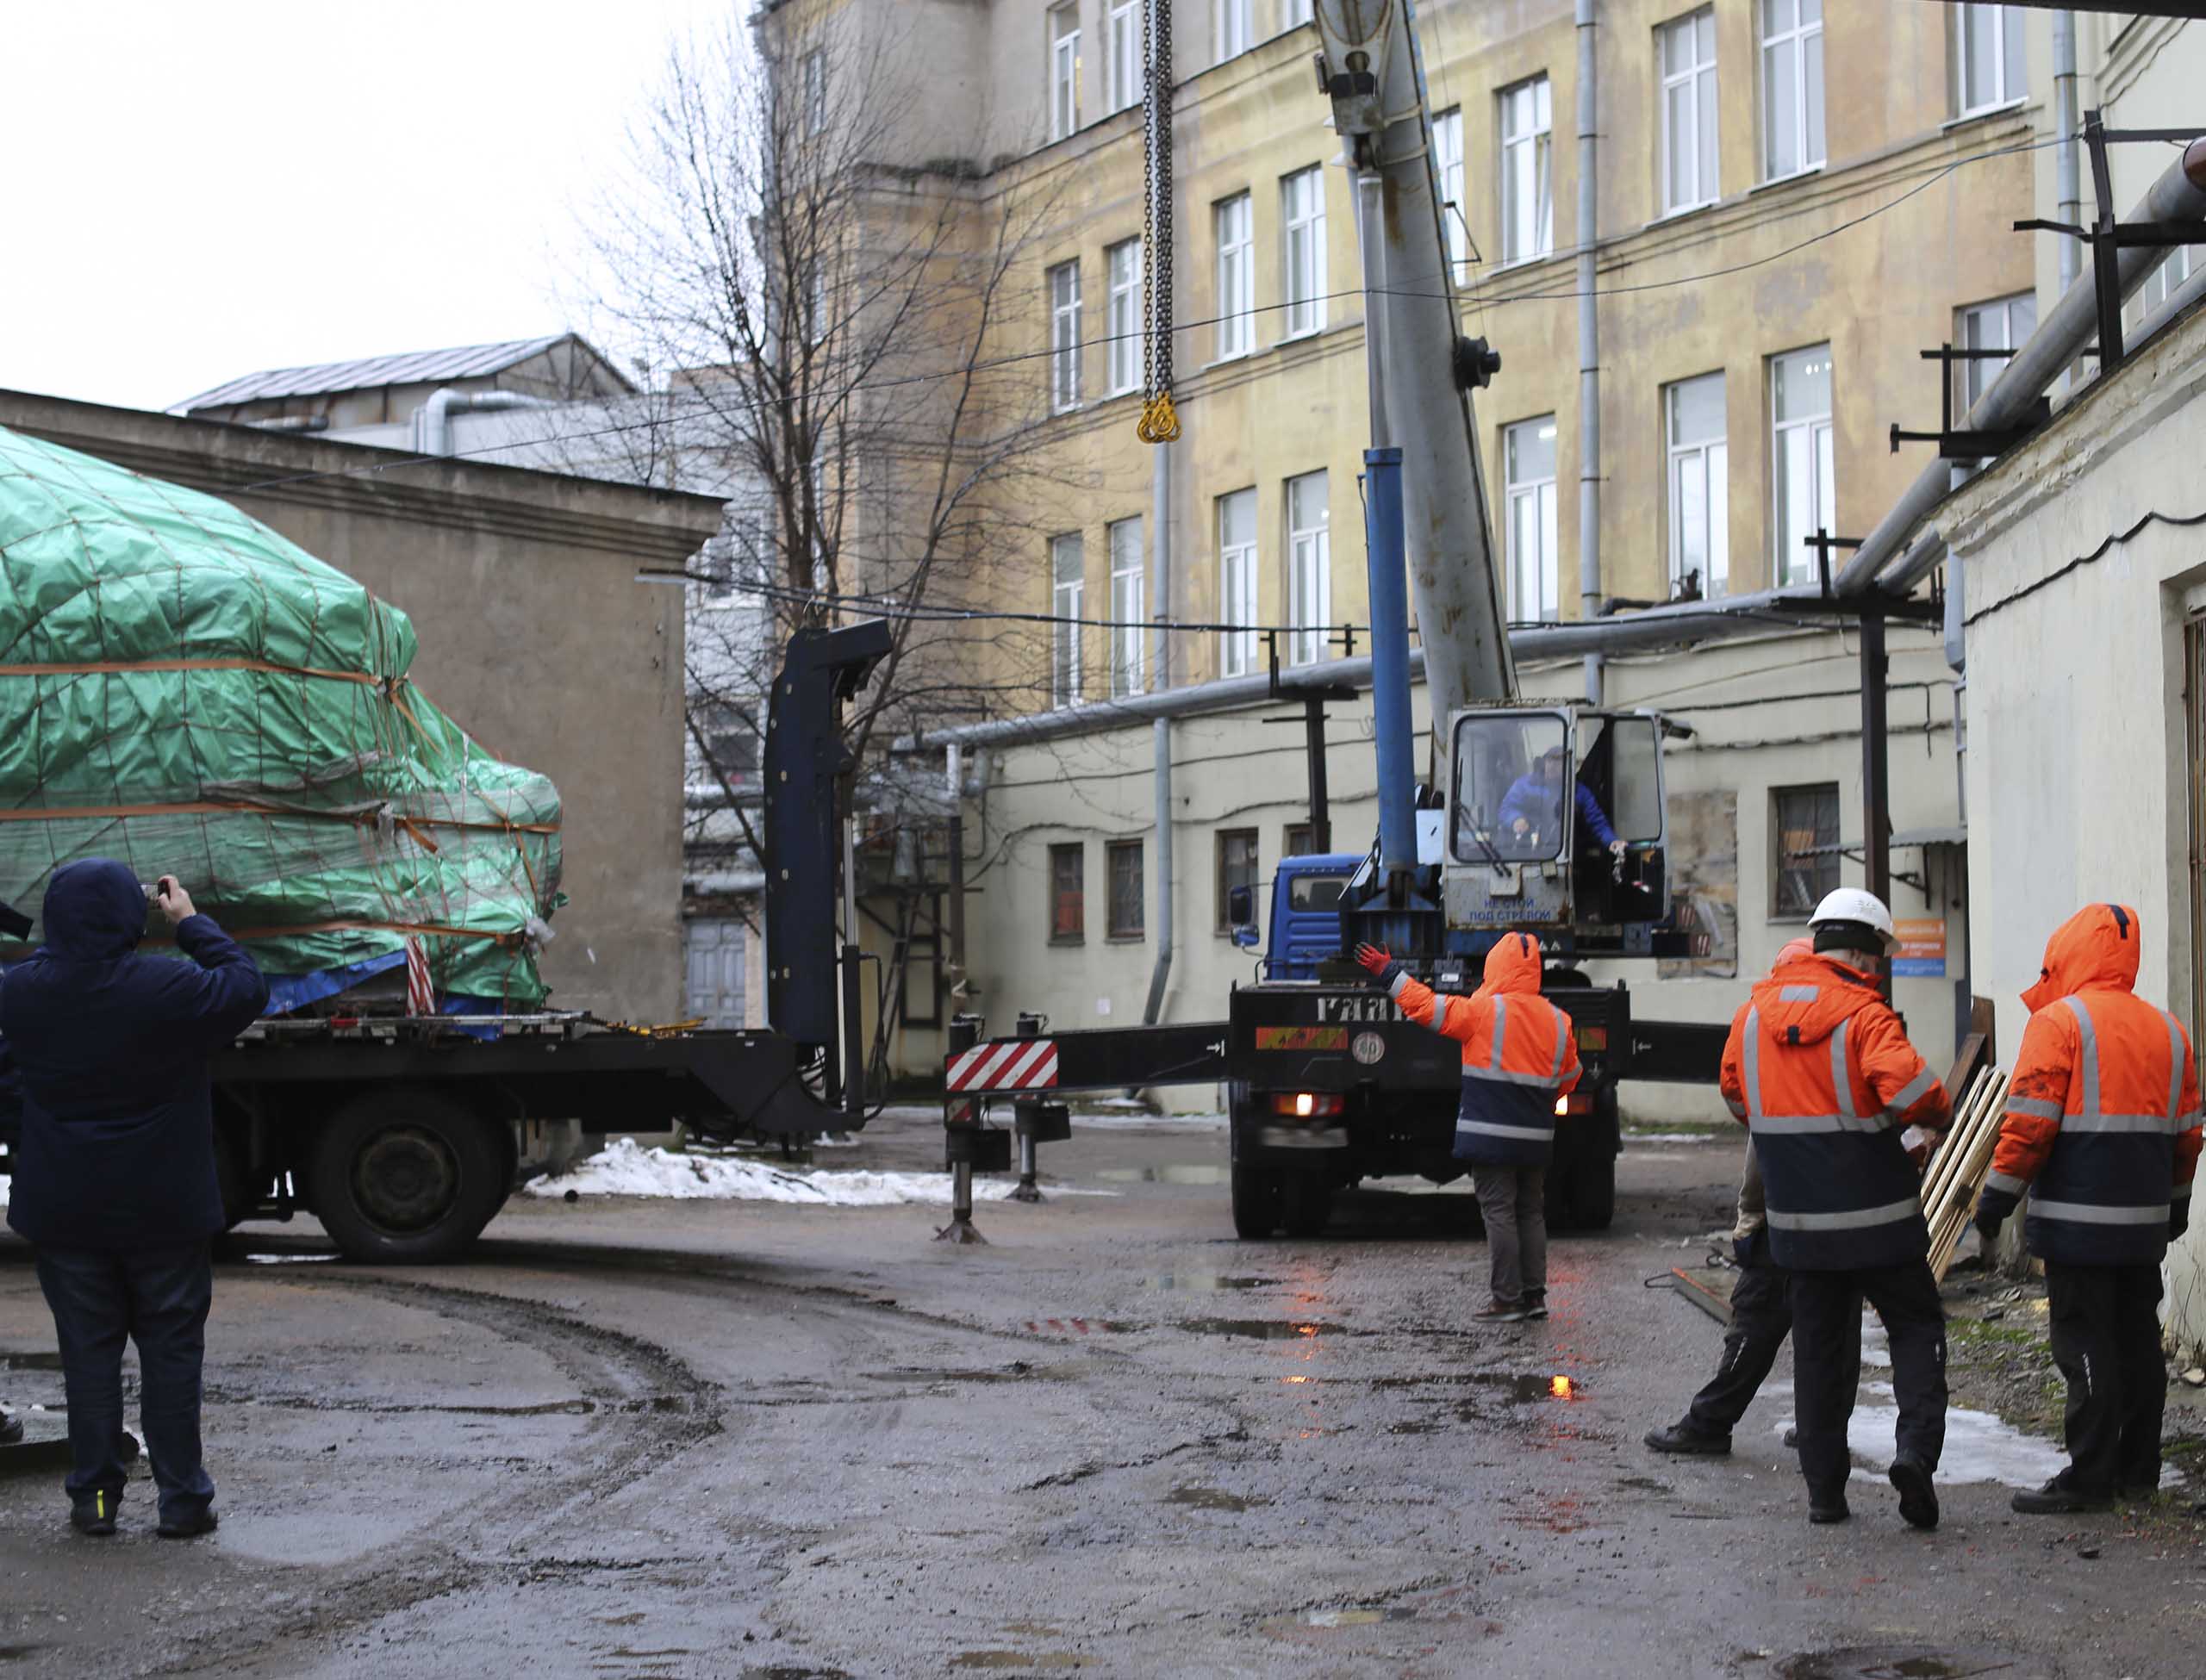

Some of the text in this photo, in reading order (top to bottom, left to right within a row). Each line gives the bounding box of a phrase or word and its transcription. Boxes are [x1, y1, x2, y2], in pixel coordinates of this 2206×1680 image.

[1484, 897, 1534, 909] НЕ СТОЙ
[1469, 911, 1494, 922] ПОД
